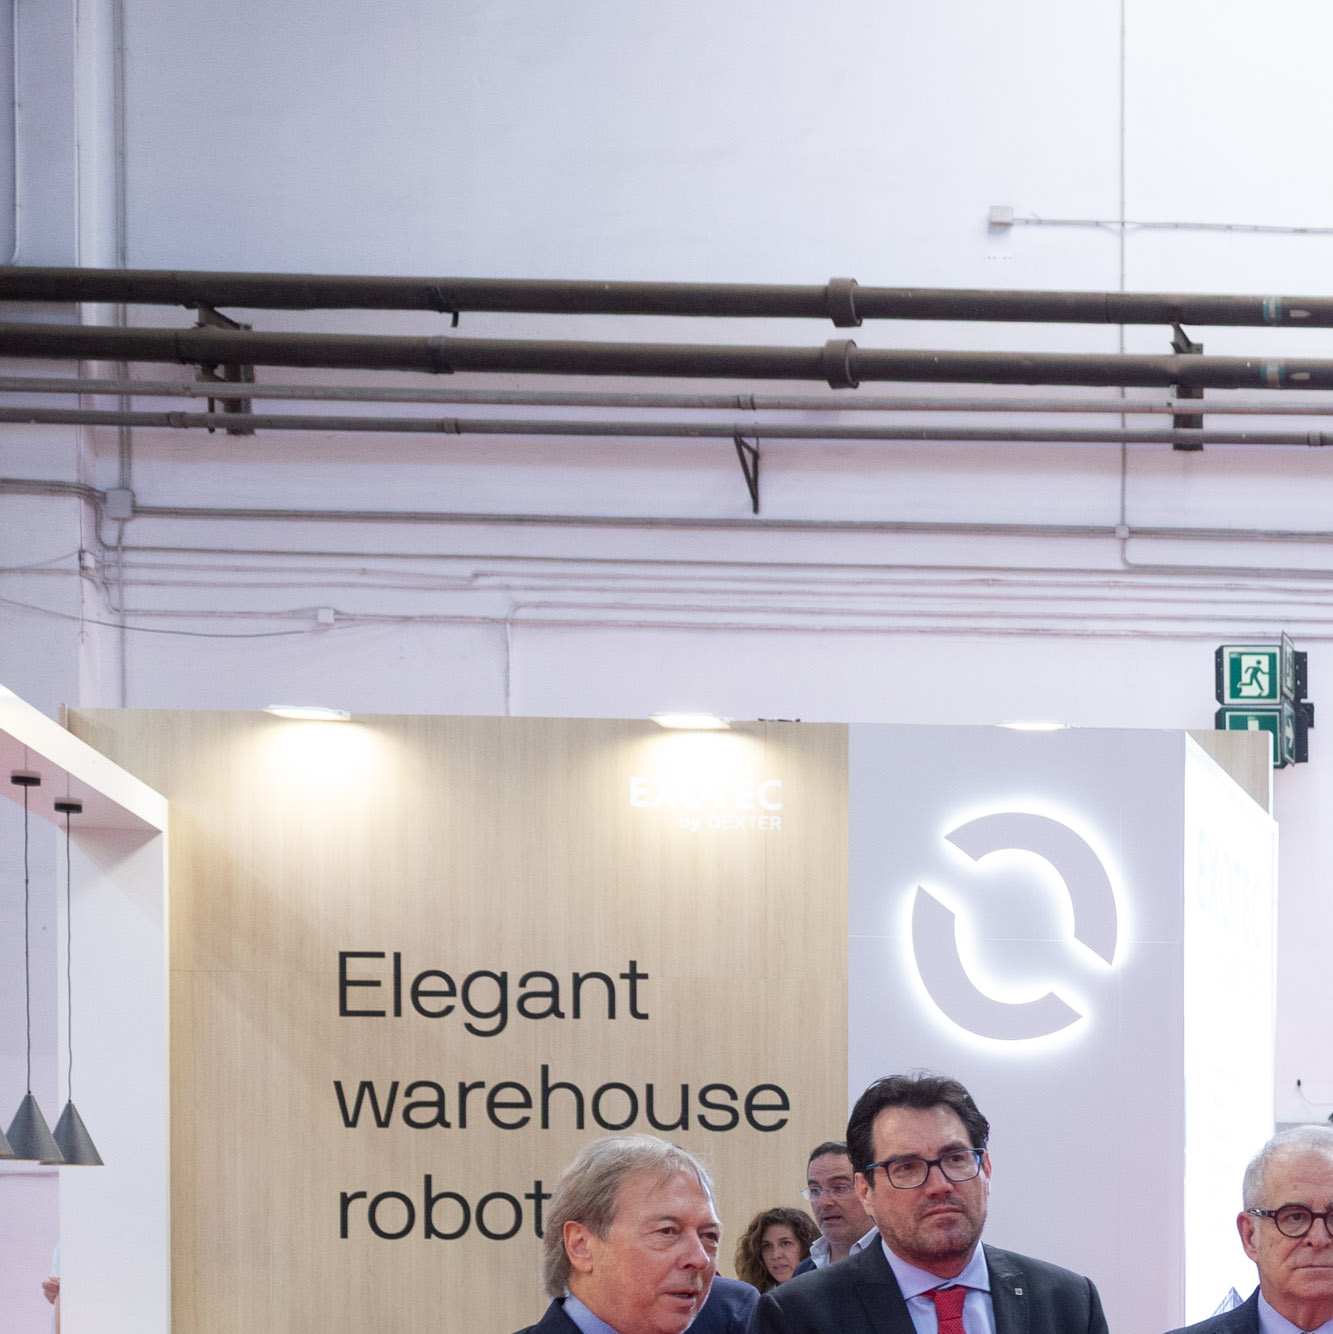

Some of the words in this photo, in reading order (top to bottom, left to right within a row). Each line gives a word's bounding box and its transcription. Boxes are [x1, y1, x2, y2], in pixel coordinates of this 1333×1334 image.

[708, 814, 783, 832] DEXTER
[338, 950, 650, 1038] Elegant
[333, 1064, 791, 1132] warehouse
